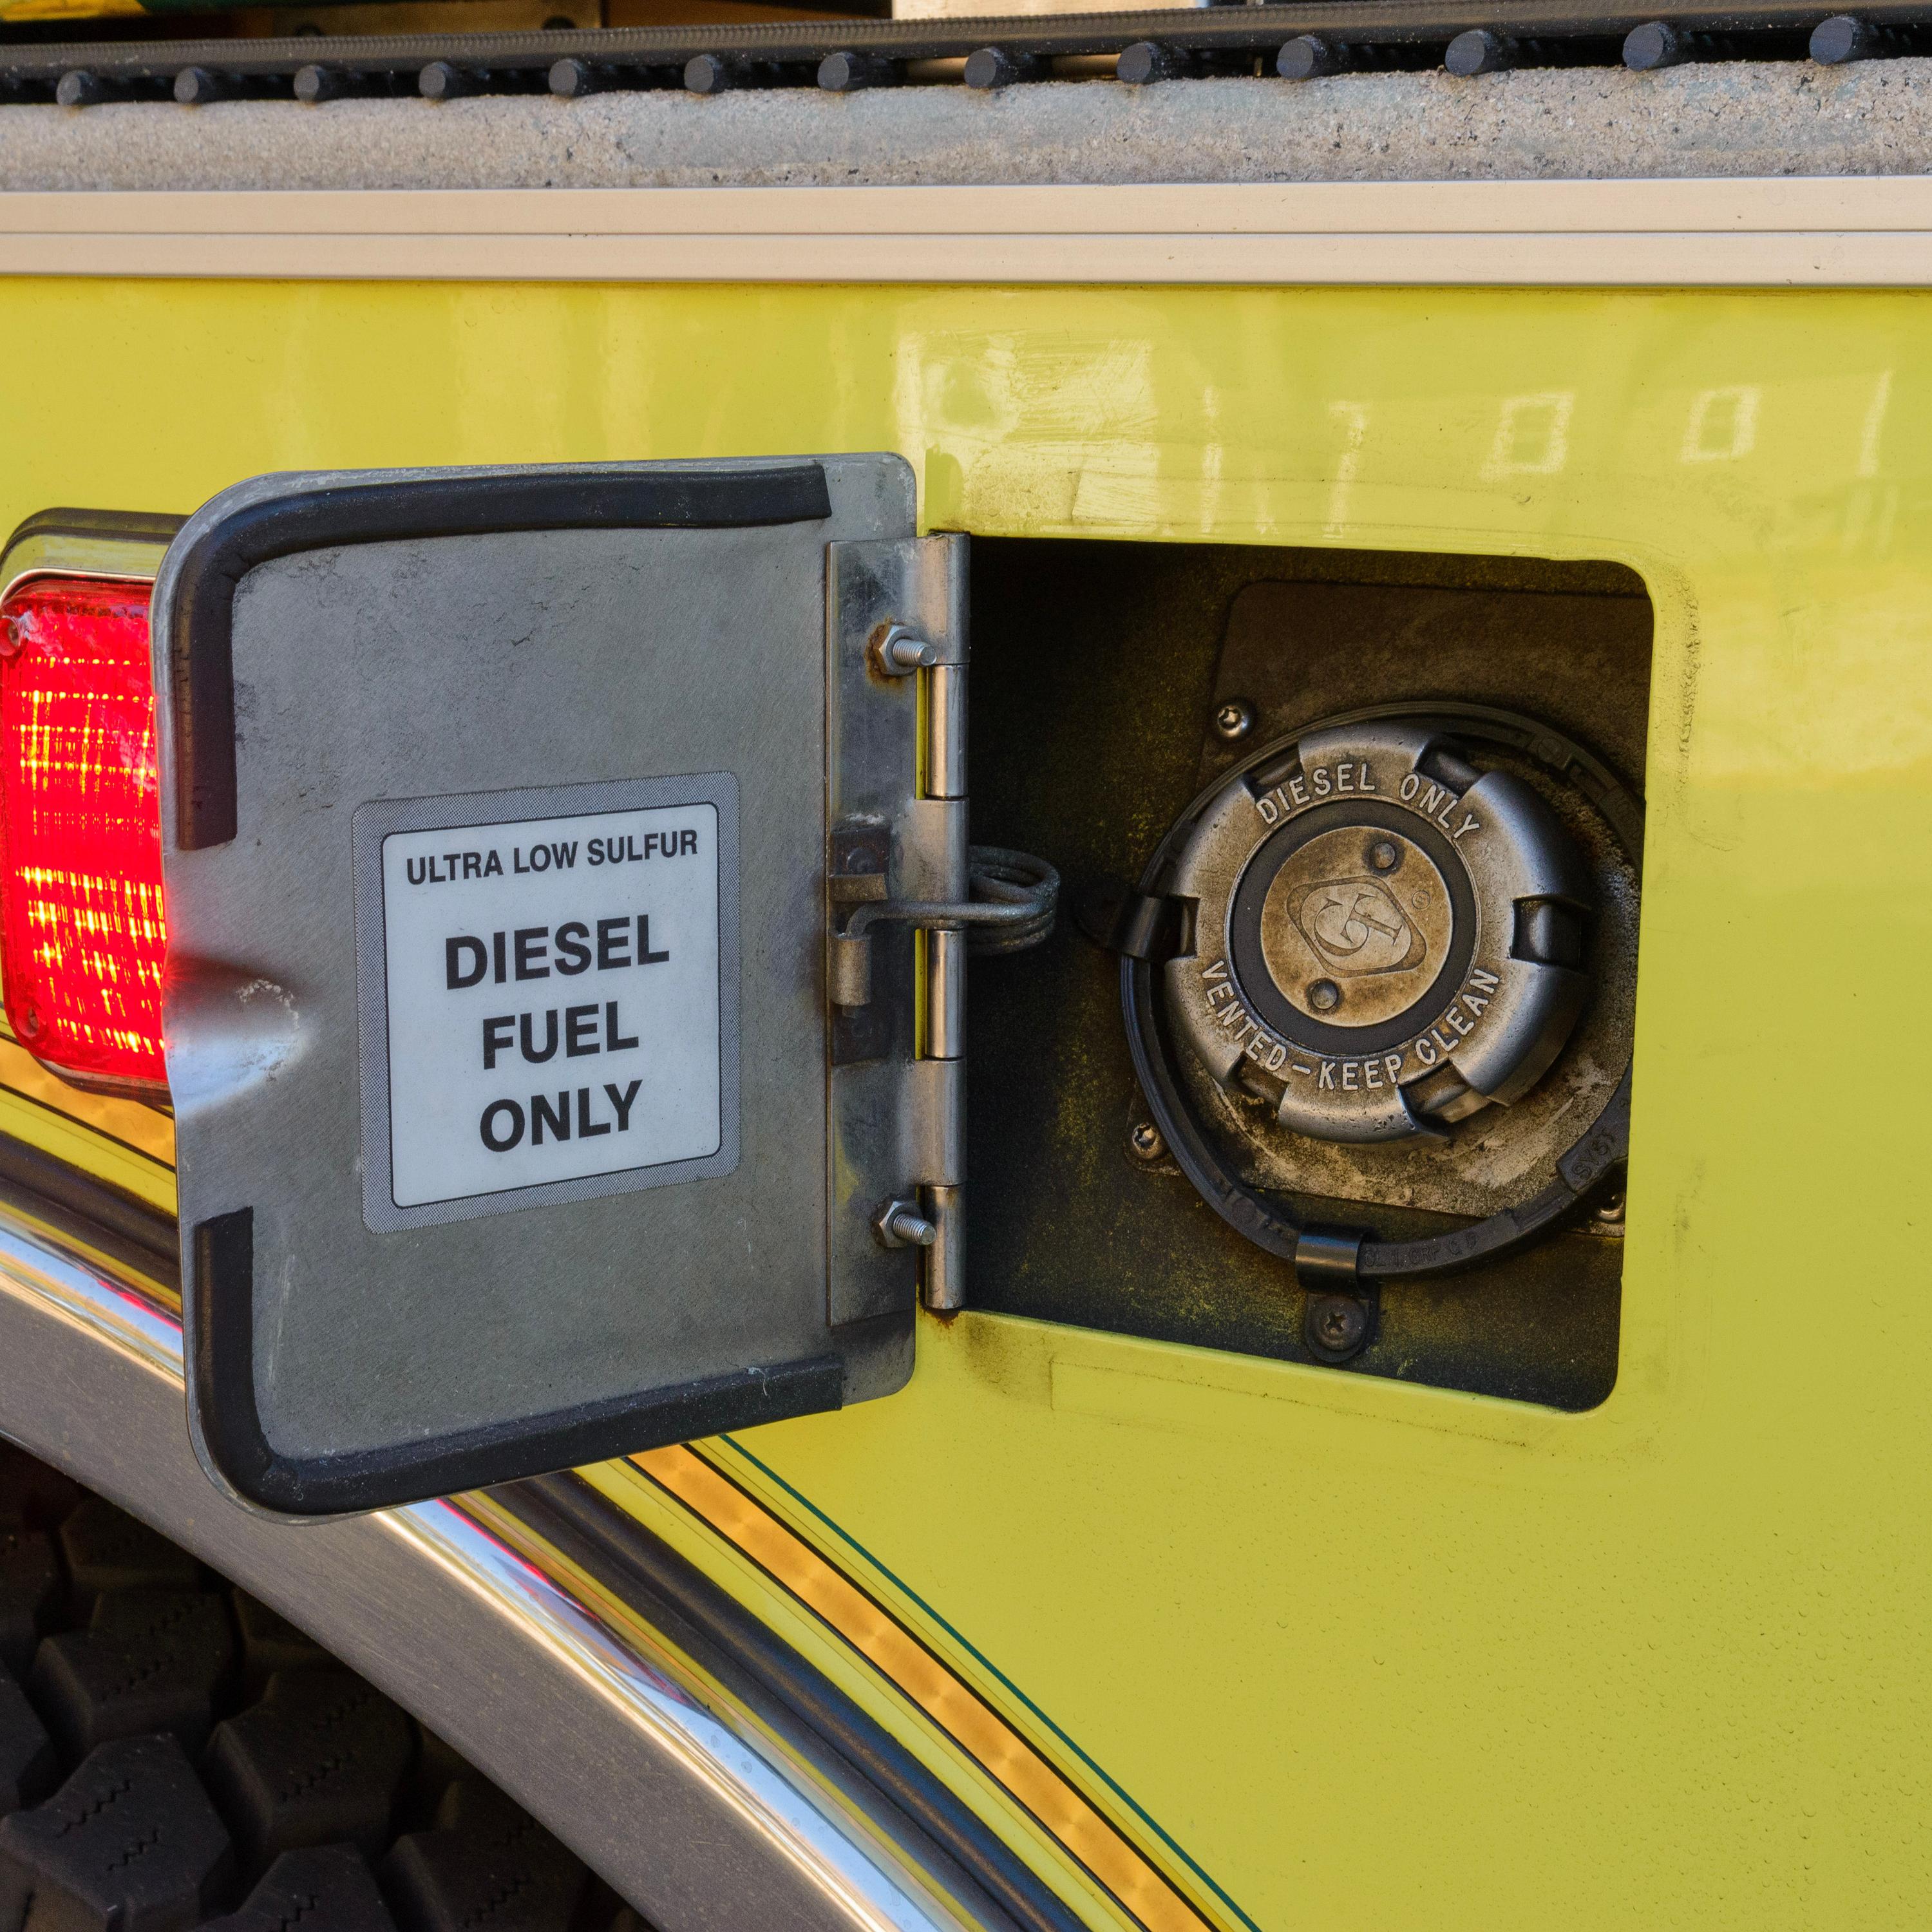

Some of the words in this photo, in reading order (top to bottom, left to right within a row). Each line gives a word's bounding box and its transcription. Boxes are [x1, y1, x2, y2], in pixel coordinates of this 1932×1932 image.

[1255, 762, 1376, 825] DIESEL
[1399, 772, 1481, 839] ONLY
[406, 849, 504, 886] ULTRA
[513, 841, 578, 875] LOW
[587, 829, 699, 866] SULFUR
[445, 914, 670, 990] DIESEL
[482, 1000, 639, 1070] FUEL
[1415, 968, 1500, 1065] CLEAN
[479, 1078, 643, 1153] ONLY
